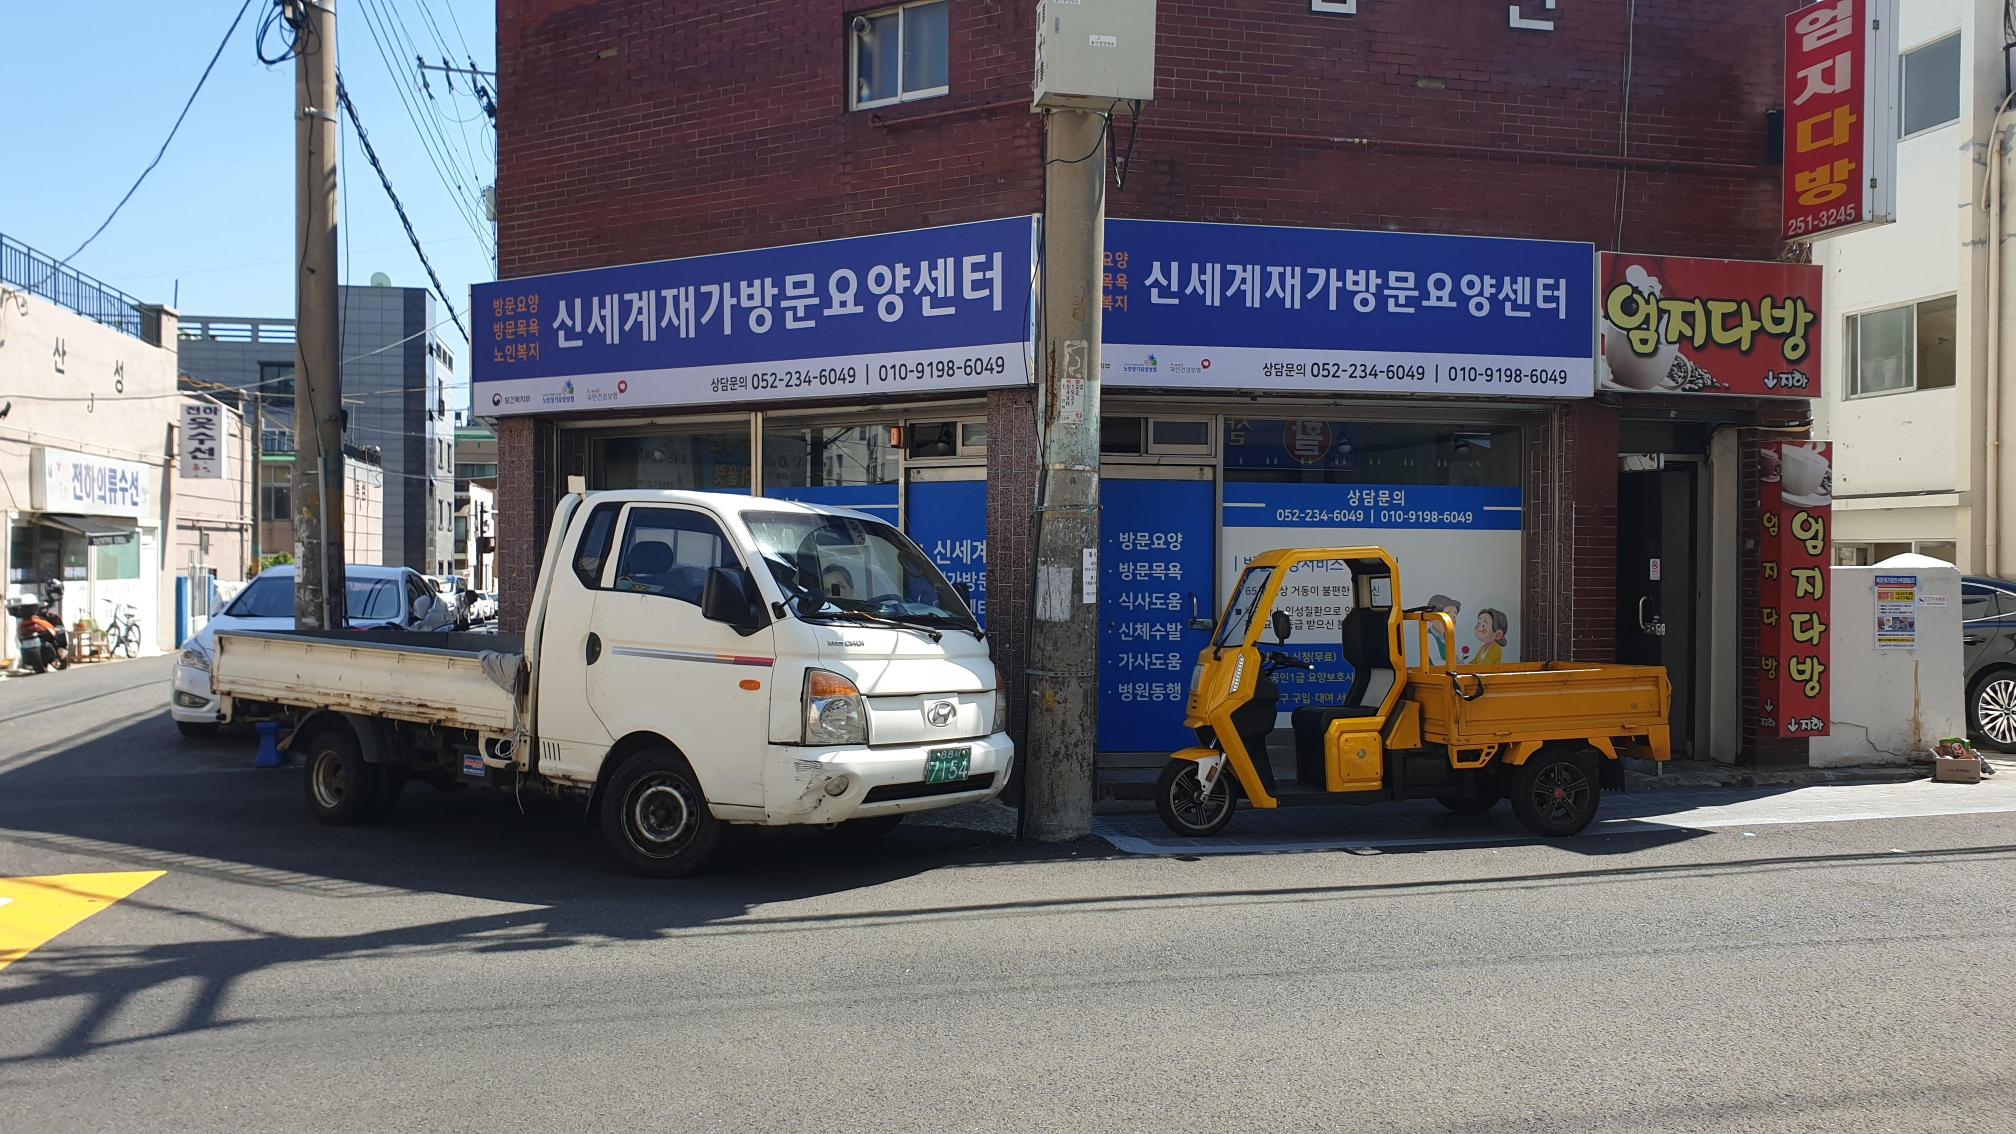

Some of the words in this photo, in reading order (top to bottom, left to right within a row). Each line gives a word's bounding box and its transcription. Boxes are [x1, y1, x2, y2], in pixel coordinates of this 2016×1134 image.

[1793, 0, 1856, 206] 엄지다방
[1788, 204, 1856, 235] 251-3245
[552, 251, 1004, 349] 신세계재가방문요양센터
[1144, 261, 1566, 320] 신세계재가방문요양센터
[492, 293, 540, 316] 방문요양
[492, 318, 540, 341] 방문목욕
[1606, 283, 1815, 361] 엄지다방
[492, 340, 540, 364] 노인복지
[710, 375, 748, 392] 상담문의
[751, 367, 856, 390] 052-234-6049
[878, 356, 1006, 382] 010-9198-6049
[1262, 362, 1306, 378] 상담문의
[1310, 362, 1425, 381] 052-234-6049
[1448, 366, 1568, 385] 010-9198-6049
[1779, 371, 1808, 388] 지하
[1347, 489, 1406, 507] 상담문의
[1276, 509, 1364, 522] 052-234-6049
[1380, 510, 1473, 524] 010-9198-6049
[1119, 532, 1183, 551] 방문요양
[1119, 562, 1183, 581] 방문목욕
[1119, 592, 1183, 611] 식사도움
[1291, 586, 1319, 597] 거동이
[1322, 585, 1350, 597] 불편한
[1761, 512, 1779, 679] 엄지다방
[1789, 510, 1826, 699] 엄지다방
[1118, 622, 1182, 641] 신체수발
[1306, 619, 1334, 631] 받으신
[1118, 652, 1182, 671] 가사도움
[1118, 682, 1182, 701] 병원동행
[1799, 716, 1824, 731] 지하
[930, 759, 968, 782] 7154
